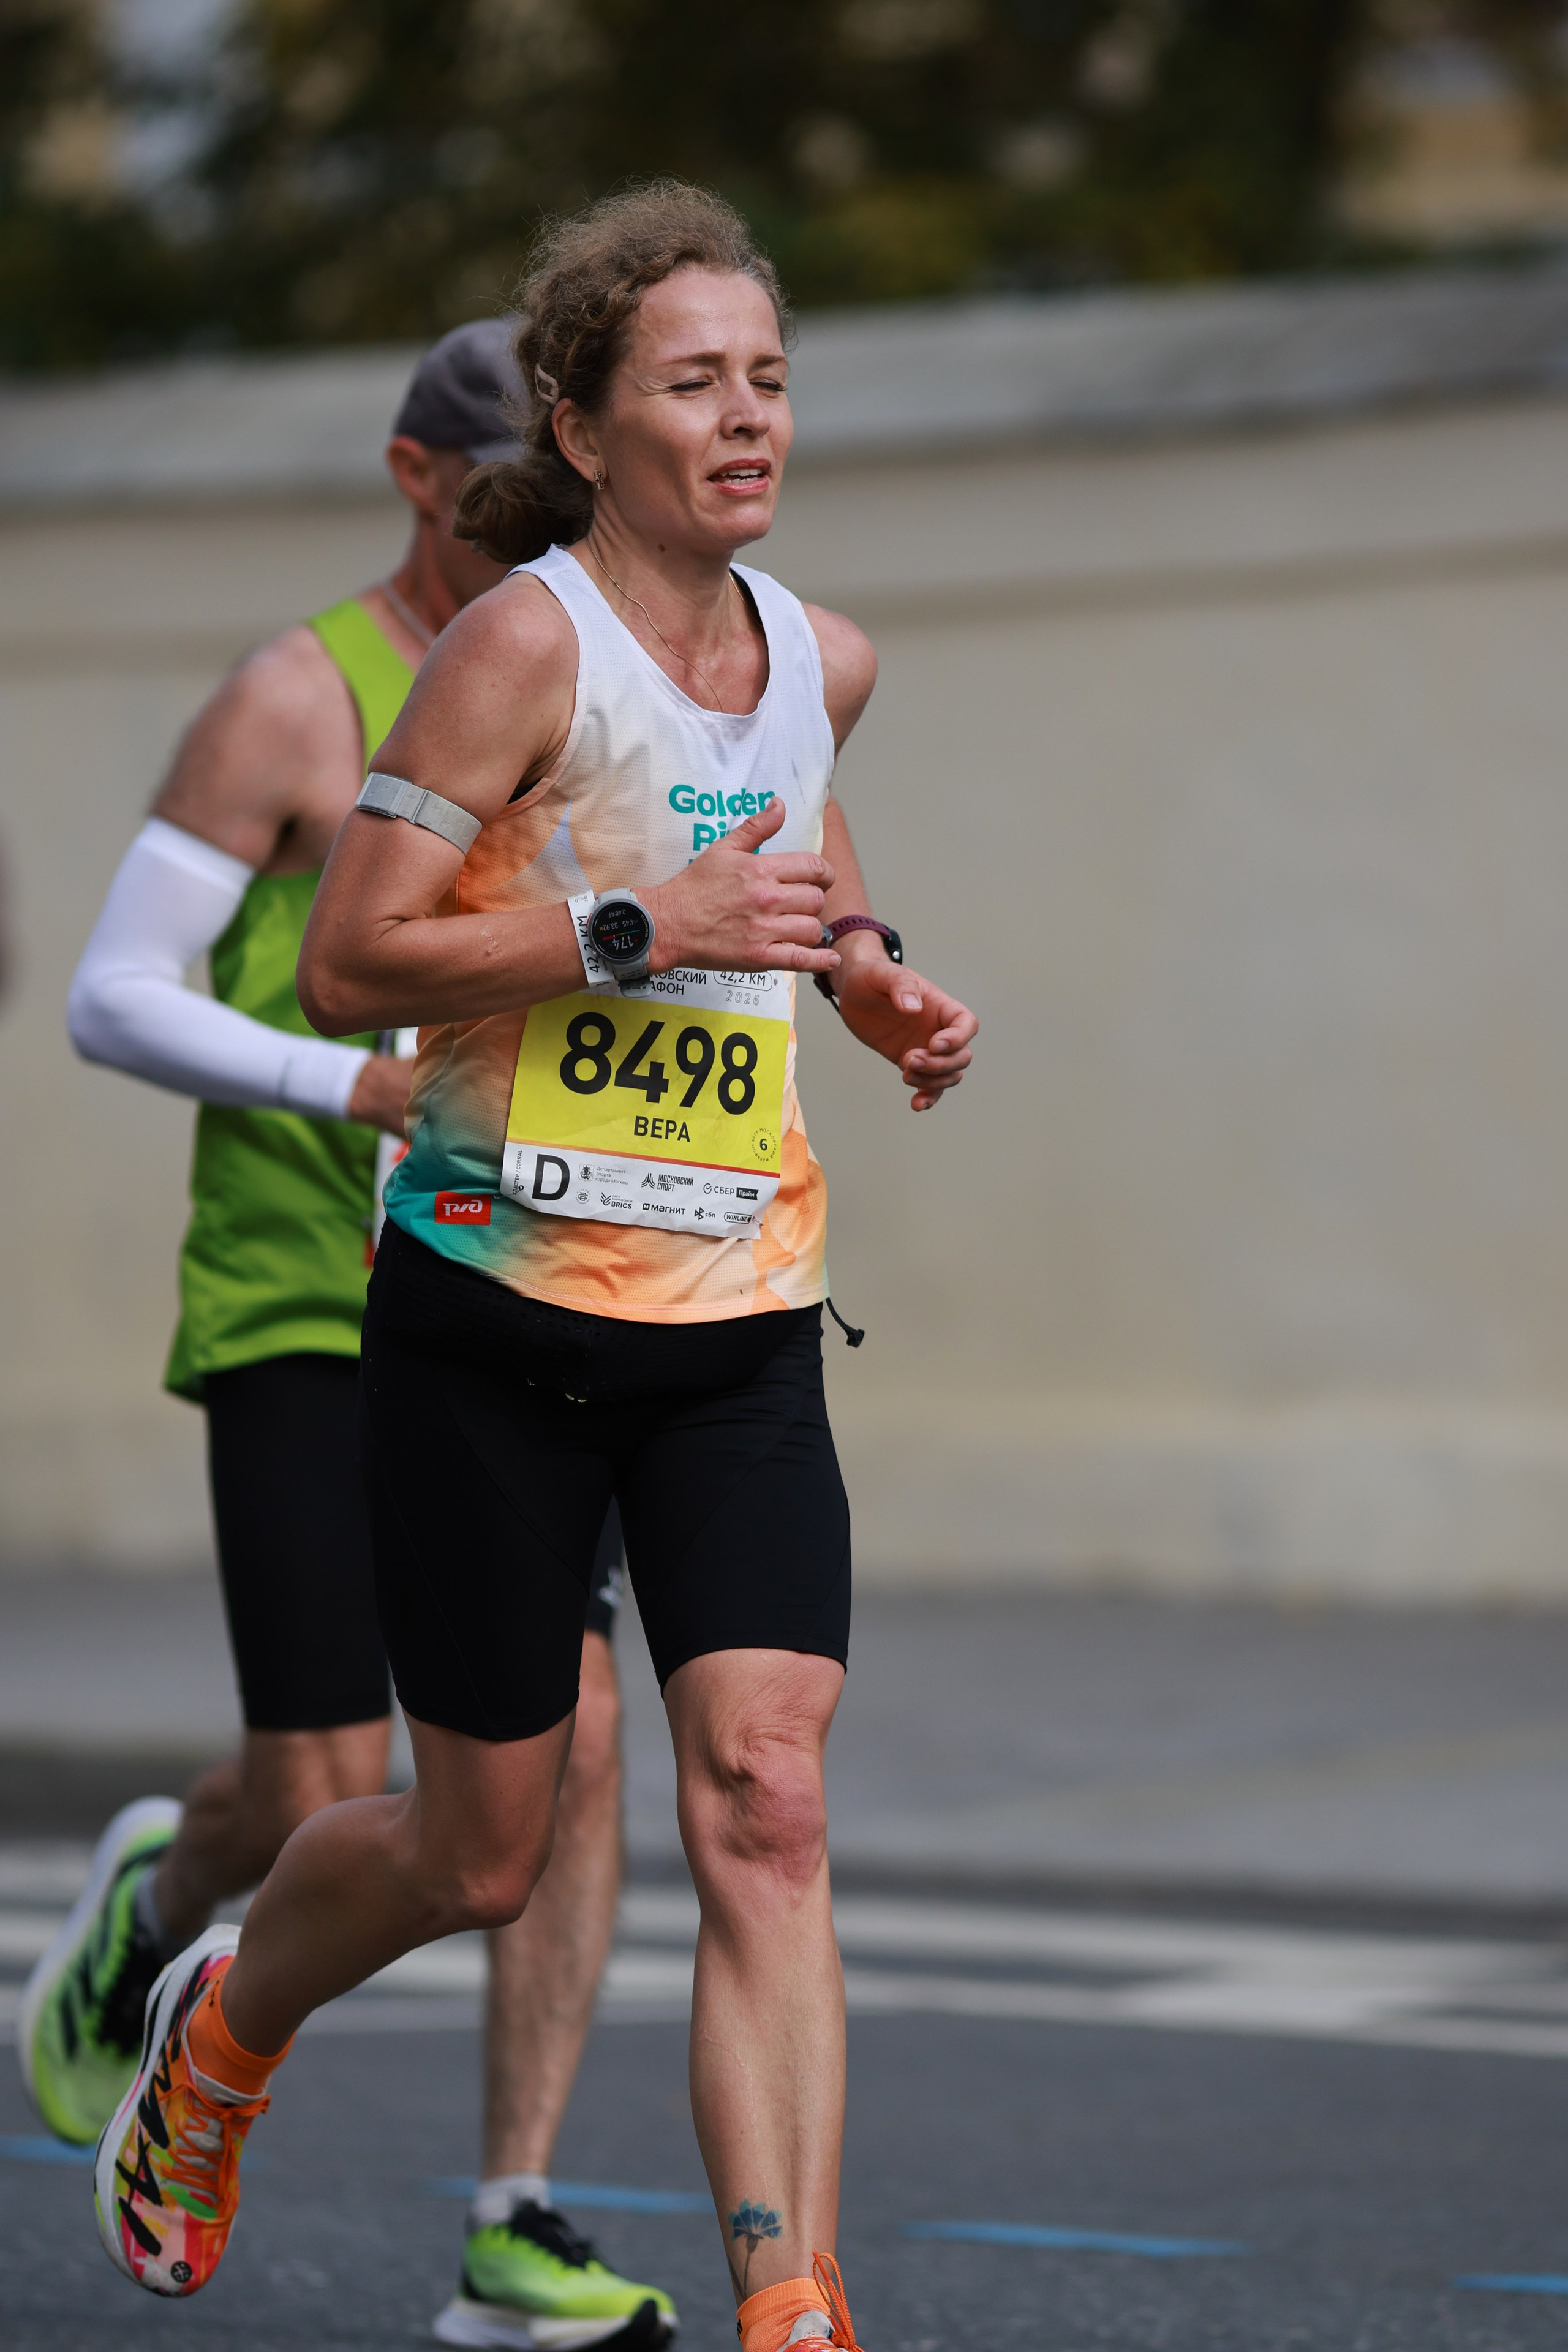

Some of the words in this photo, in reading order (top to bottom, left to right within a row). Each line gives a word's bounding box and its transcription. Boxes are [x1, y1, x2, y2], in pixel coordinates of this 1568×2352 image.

[603, 922, 619, 931] 33.92
[612, 935, 634, 951] 174
[720, 971, 745, 984] 42,2
[749, 973, 766, 986] КМ
[725, 990, 760, 1006] 2026
[560, 1012, 758, 1115] 8498
[634, 1115, 691, 1142] ВЕРА
[760, 1138, 767, 1151] 6
[532, 1153, 570, 1201] D
[658, 1174, 694, 1186] МОСКОВСКИЙ
[657, 1182, 675, 1192] СПОРТ
[714, 1186, 734, 1195] СБЕР
[611, 1200, 632, 1210] BRICS
[726, 1213, 748, 1223] WINLINE
